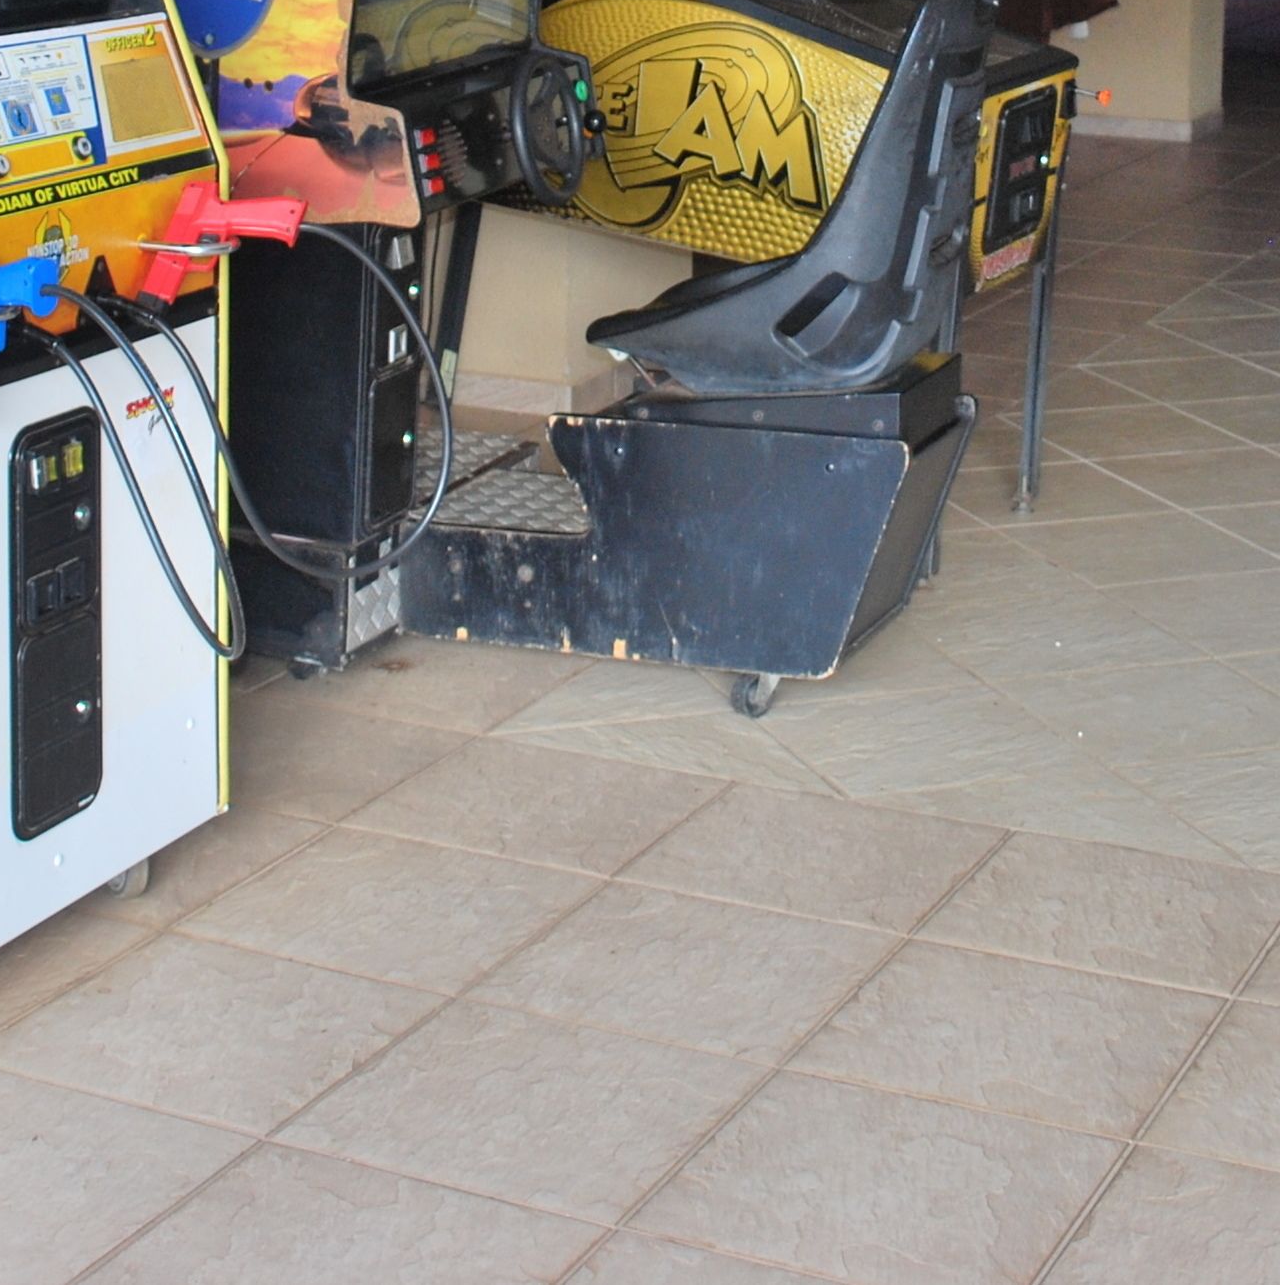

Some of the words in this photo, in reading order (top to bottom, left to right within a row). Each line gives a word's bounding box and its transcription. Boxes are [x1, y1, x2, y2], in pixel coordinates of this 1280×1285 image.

[104, 33, 146, 53] OFFICER
[143, 24, 157, 47] 2
[34, 185, 55, 207] OF
[56, 174, 108, 201] VIRTUA
[108, 166, 141, 190] CITY
